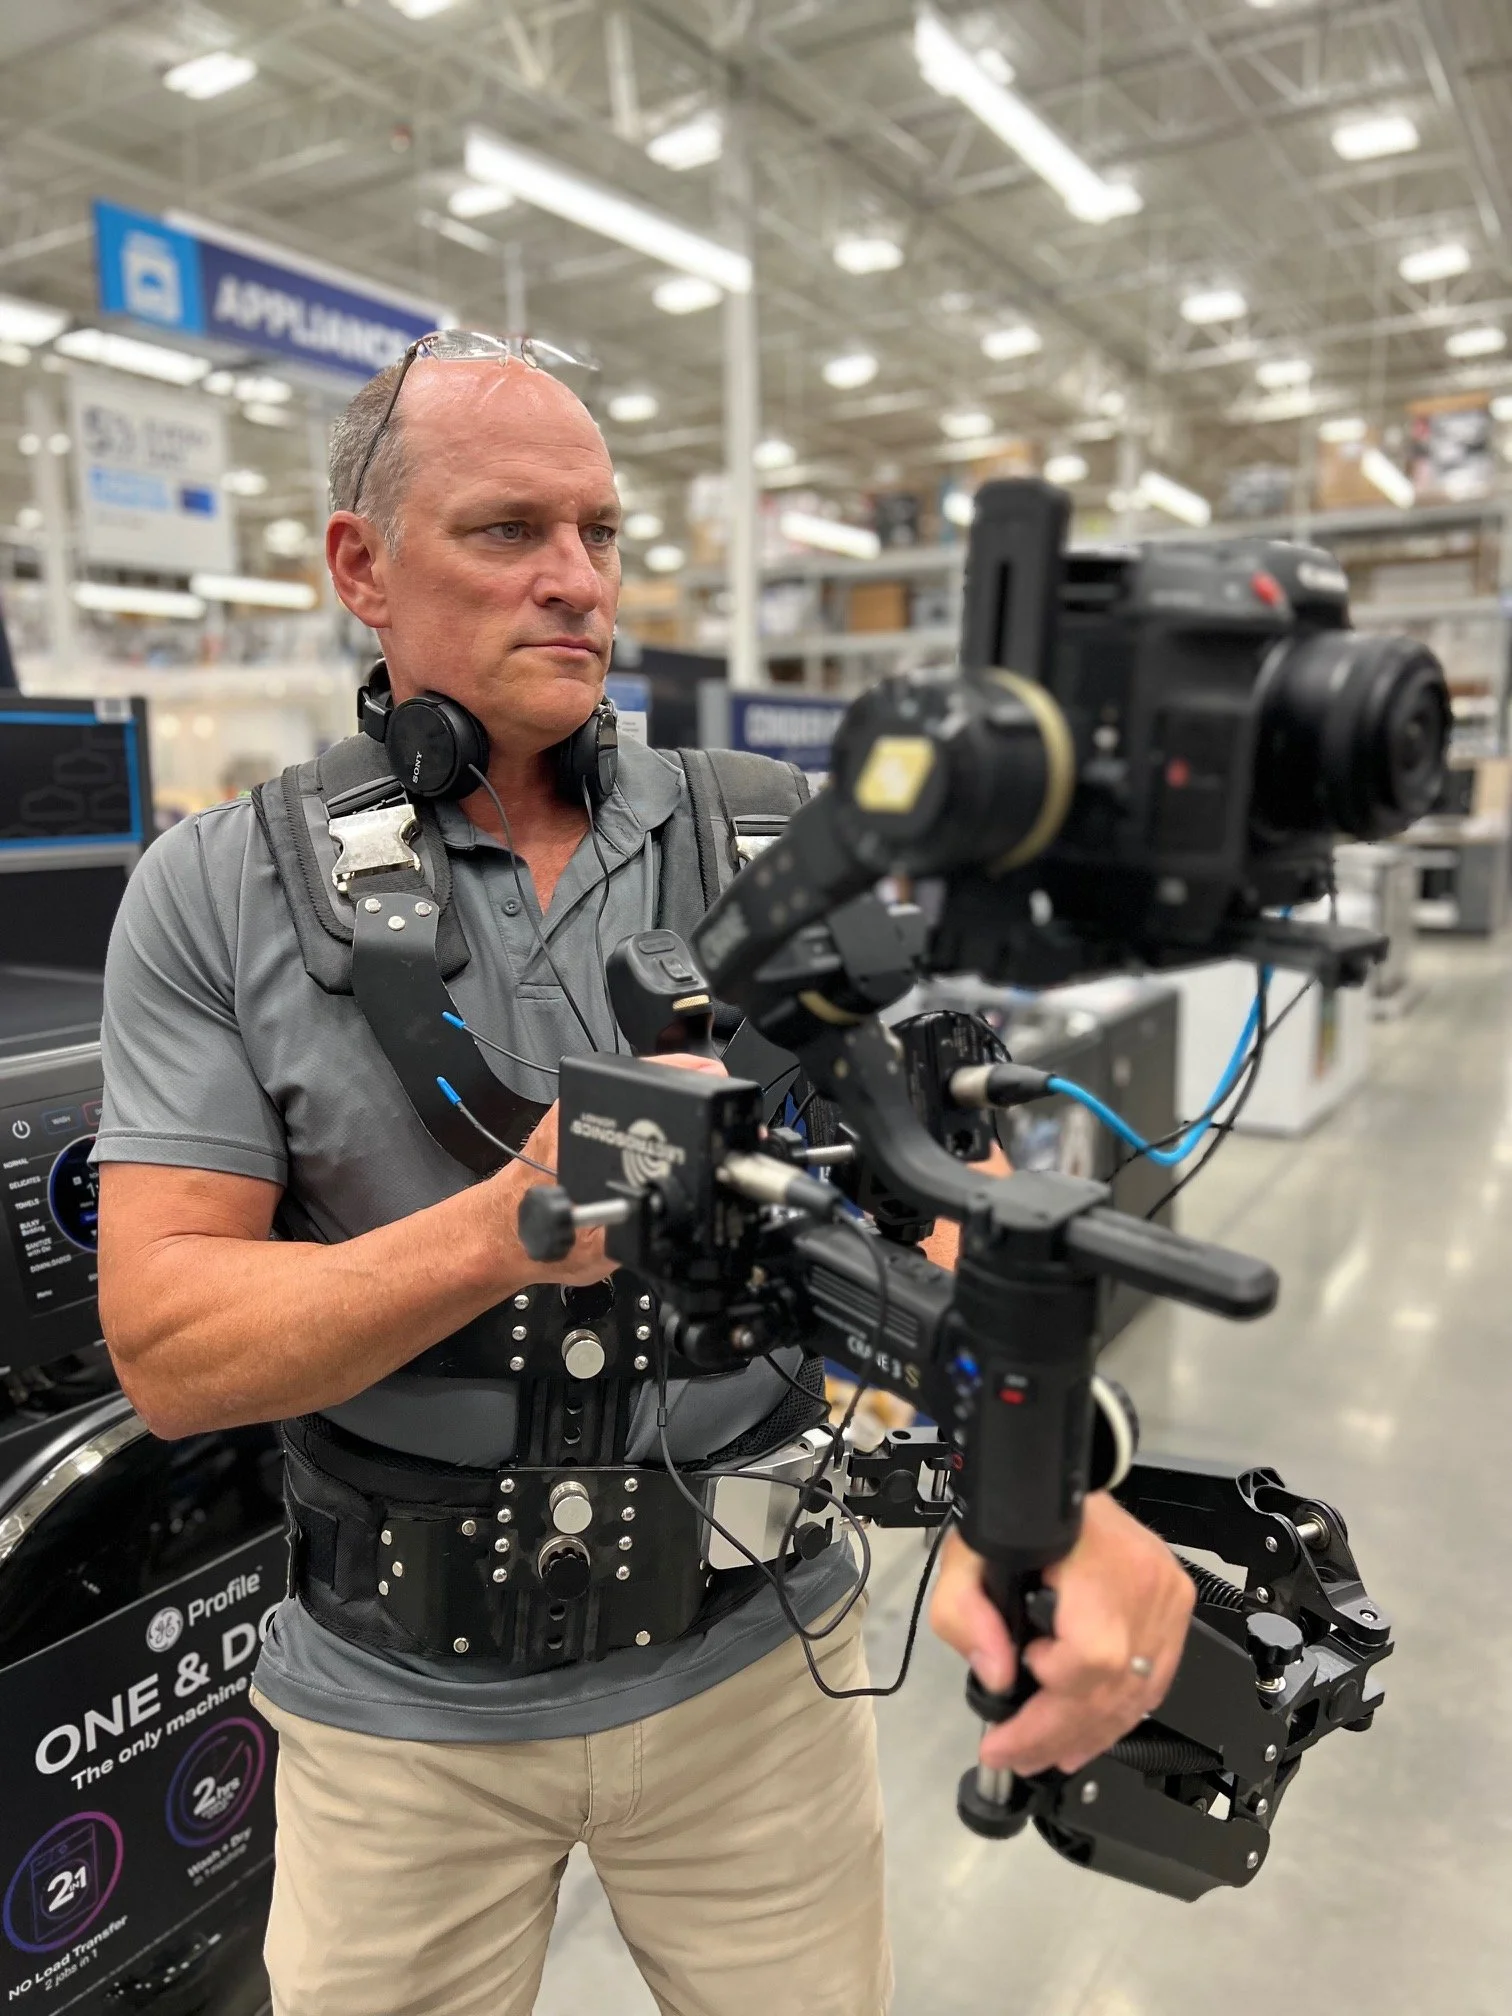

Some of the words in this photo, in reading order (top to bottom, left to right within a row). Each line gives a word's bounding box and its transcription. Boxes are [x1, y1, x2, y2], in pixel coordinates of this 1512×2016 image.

[412, 751, 423, 784] SONY
[3, 1158, 29, 1169] NORMAL
[9, 1176, 41, 1190] DELICATES
[15, 1198, 40, 1210] TOWELS
[19, 1219, 40, 1230] BULKY
[21, 1225, 46, 1237] Bedding
[30, 1254, 72, 1273] DOWNLOADED
[188, 1573, 260, 1627] Profile
[35, 1673, 161, 1775] ONE
[174, 1652, 211, 1697] &
[71, 1757, 114, 1790] The
[118, 1728, 162, 1763] only
[166, 1677, 247, 1735] machine
[8, 1979, 32, 2001] NO
[35, 1953, 71, 1983] Load
[72, 1915, 128, 1957] Transfer
[45, 1979, 53, 1991] 2
[55, 1961, 77, 1987] jobs
[79, 1955, 90, 1967] in
[91, 1948, 98, 1958] 1
